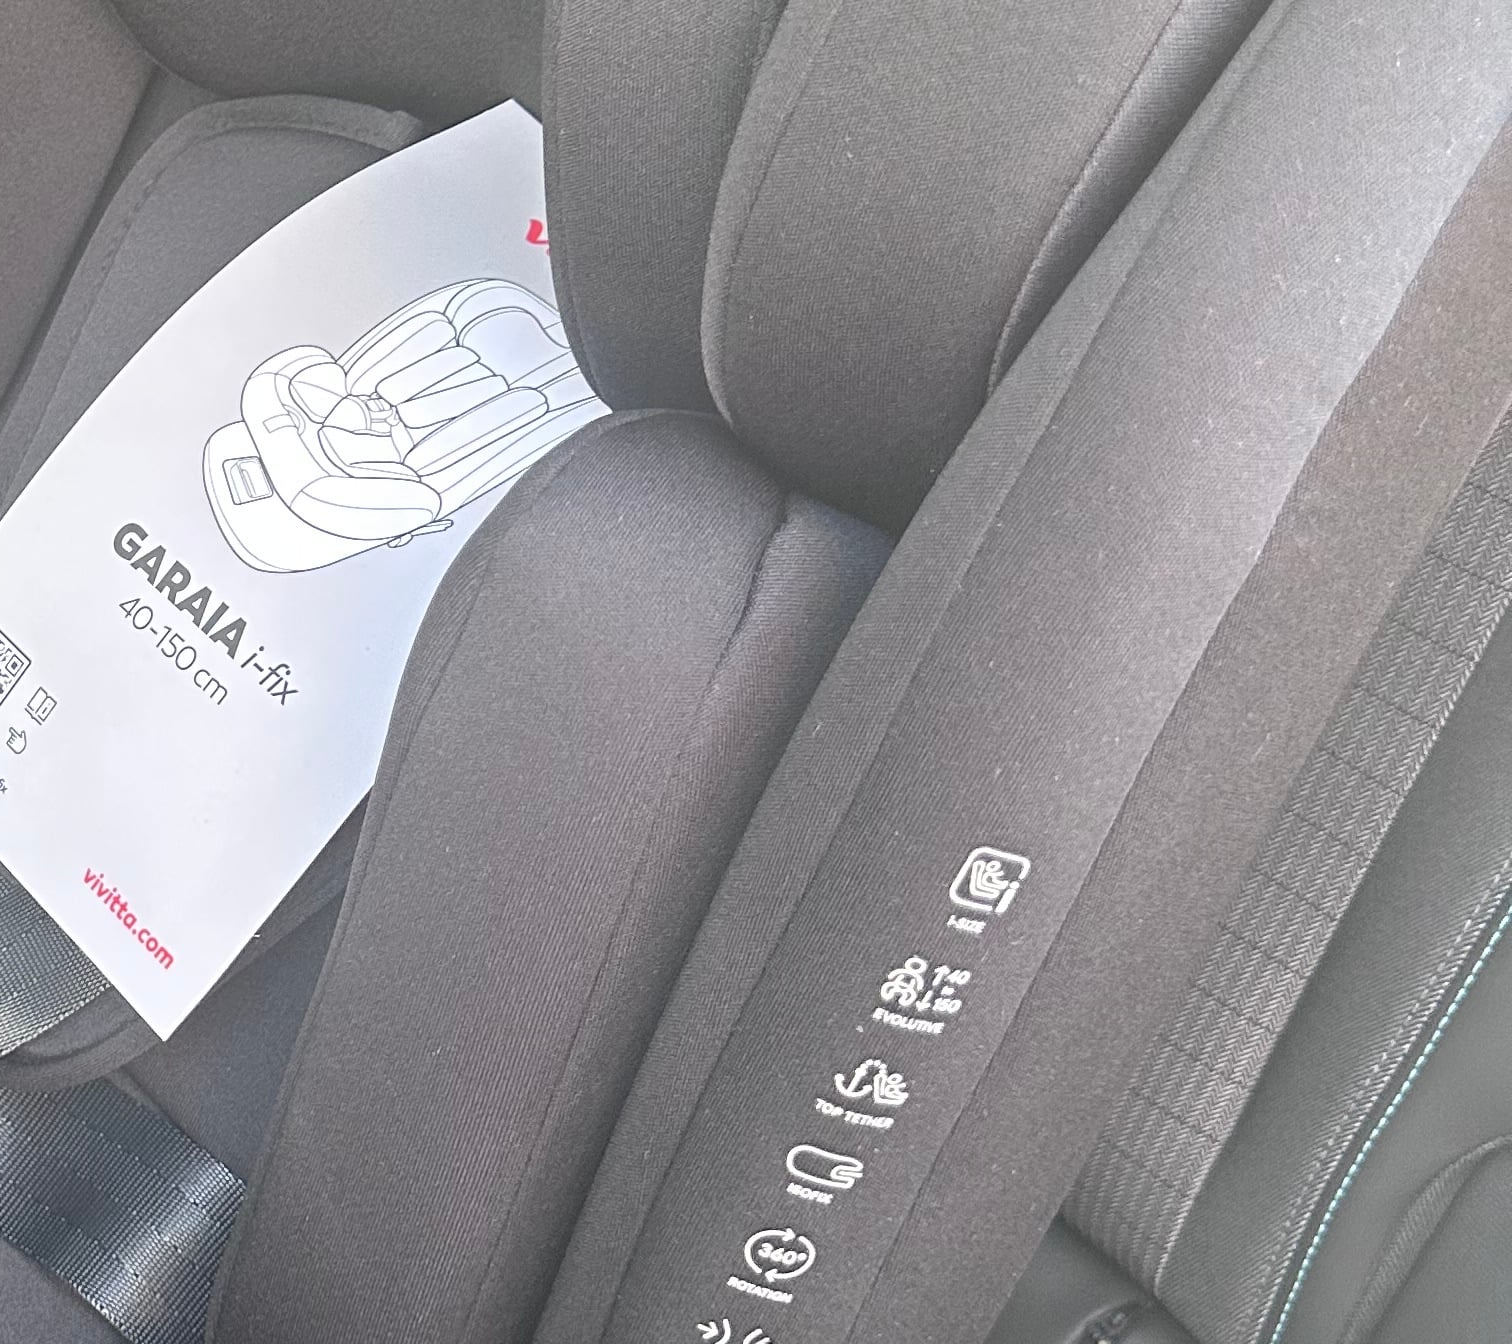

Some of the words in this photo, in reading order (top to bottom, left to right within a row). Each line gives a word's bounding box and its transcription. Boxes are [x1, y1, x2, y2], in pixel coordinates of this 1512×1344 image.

[113, 522, 247, 660] GARAIA
[240, 645, 299, 706] i-fix
[118, 597, 197, 671] 40-150
[193, 668, 228, 706] cm
[83, 867, 174, 970] vivitta.com
[727, 1275, 793, 1303] ROTATION
